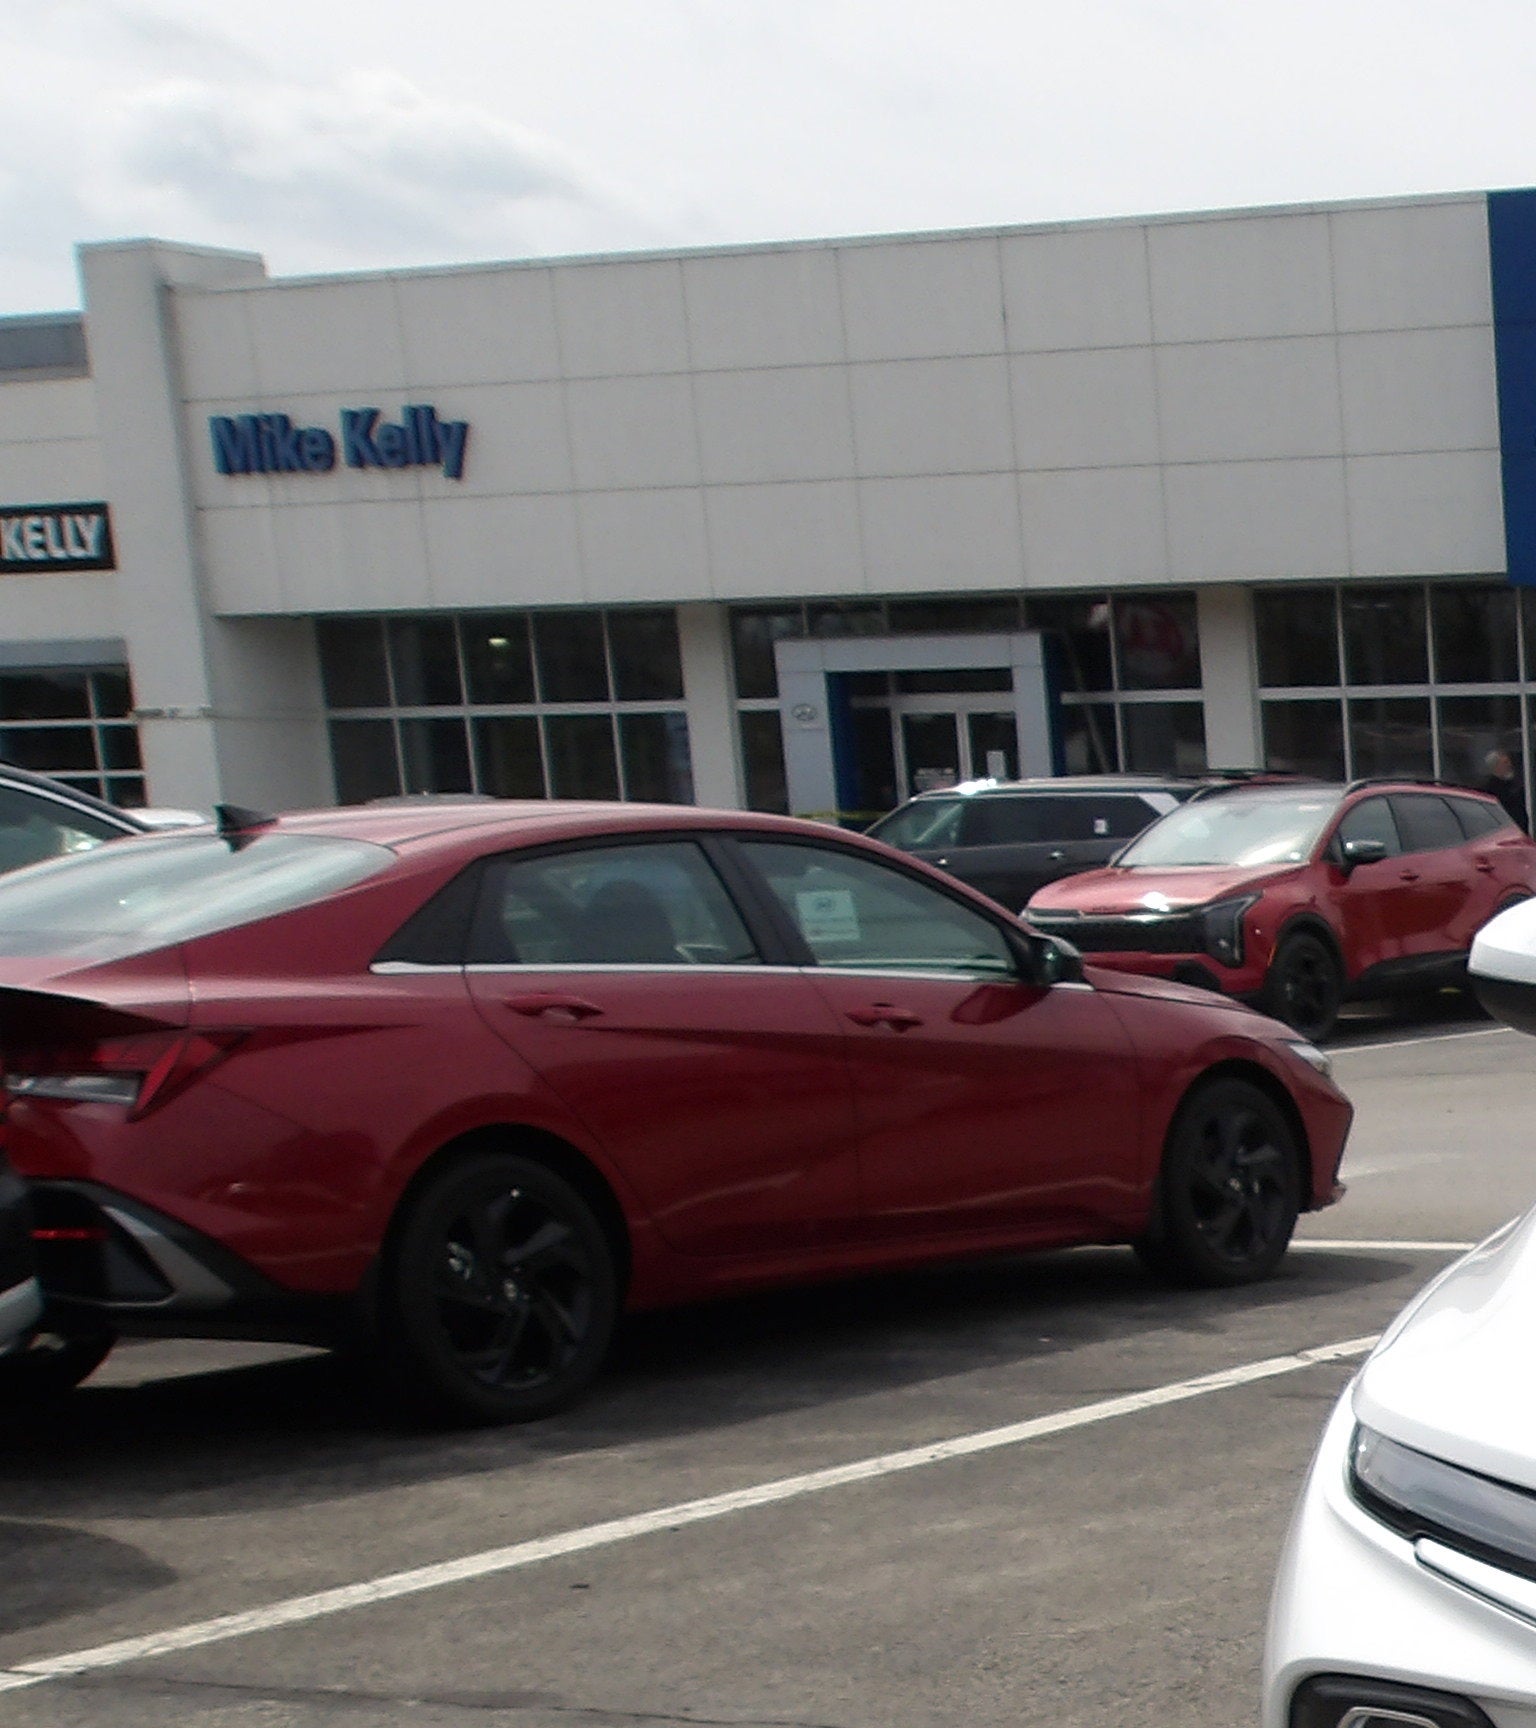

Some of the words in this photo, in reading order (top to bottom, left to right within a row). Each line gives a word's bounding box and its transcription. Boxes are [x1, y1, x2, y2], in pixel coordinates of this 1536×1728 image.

[210, 413, 336, 475] Mike
[340, 404, 469, 480] Kelly
[0, 514, 100, 560] KELLY
